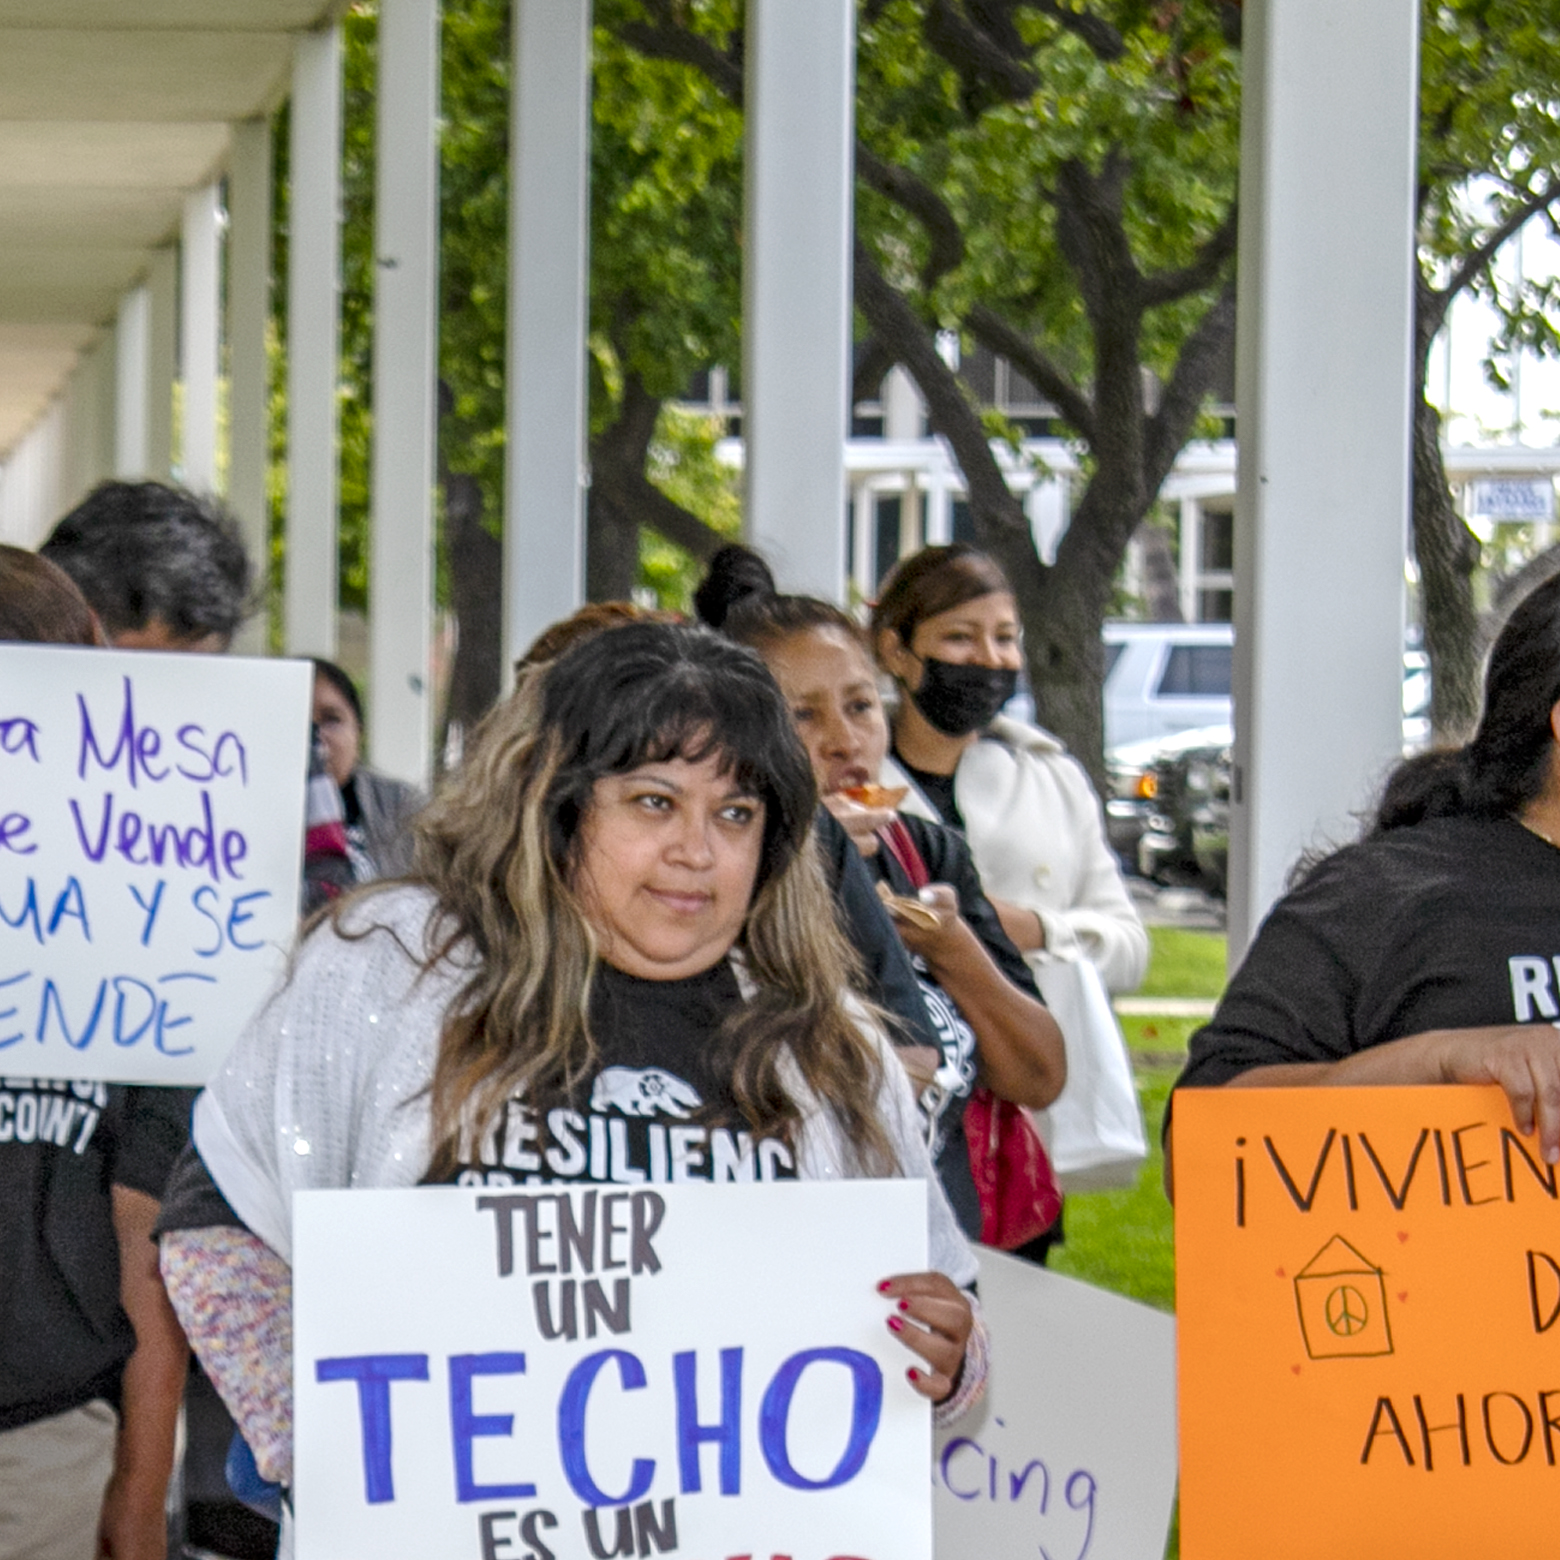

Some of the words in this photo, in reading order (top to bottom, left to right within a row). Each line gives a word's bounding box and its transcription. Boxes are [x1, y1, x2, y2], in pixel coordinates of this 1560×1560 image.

[75, 676, 250, 790] Mesa
[68, 788, 250, 885] Vende
[127, 878, 167, 949] Y
[191, 883, 274, 958] SE
[457, 1098, 794, 1184] RESILIENC
[476, 1188, 667, 1280] TENER
[532, 1277, 633, 1342] UN
[314, 1346, 884, 1509] TECHO
[581, 1497, 680, 1560] UN
